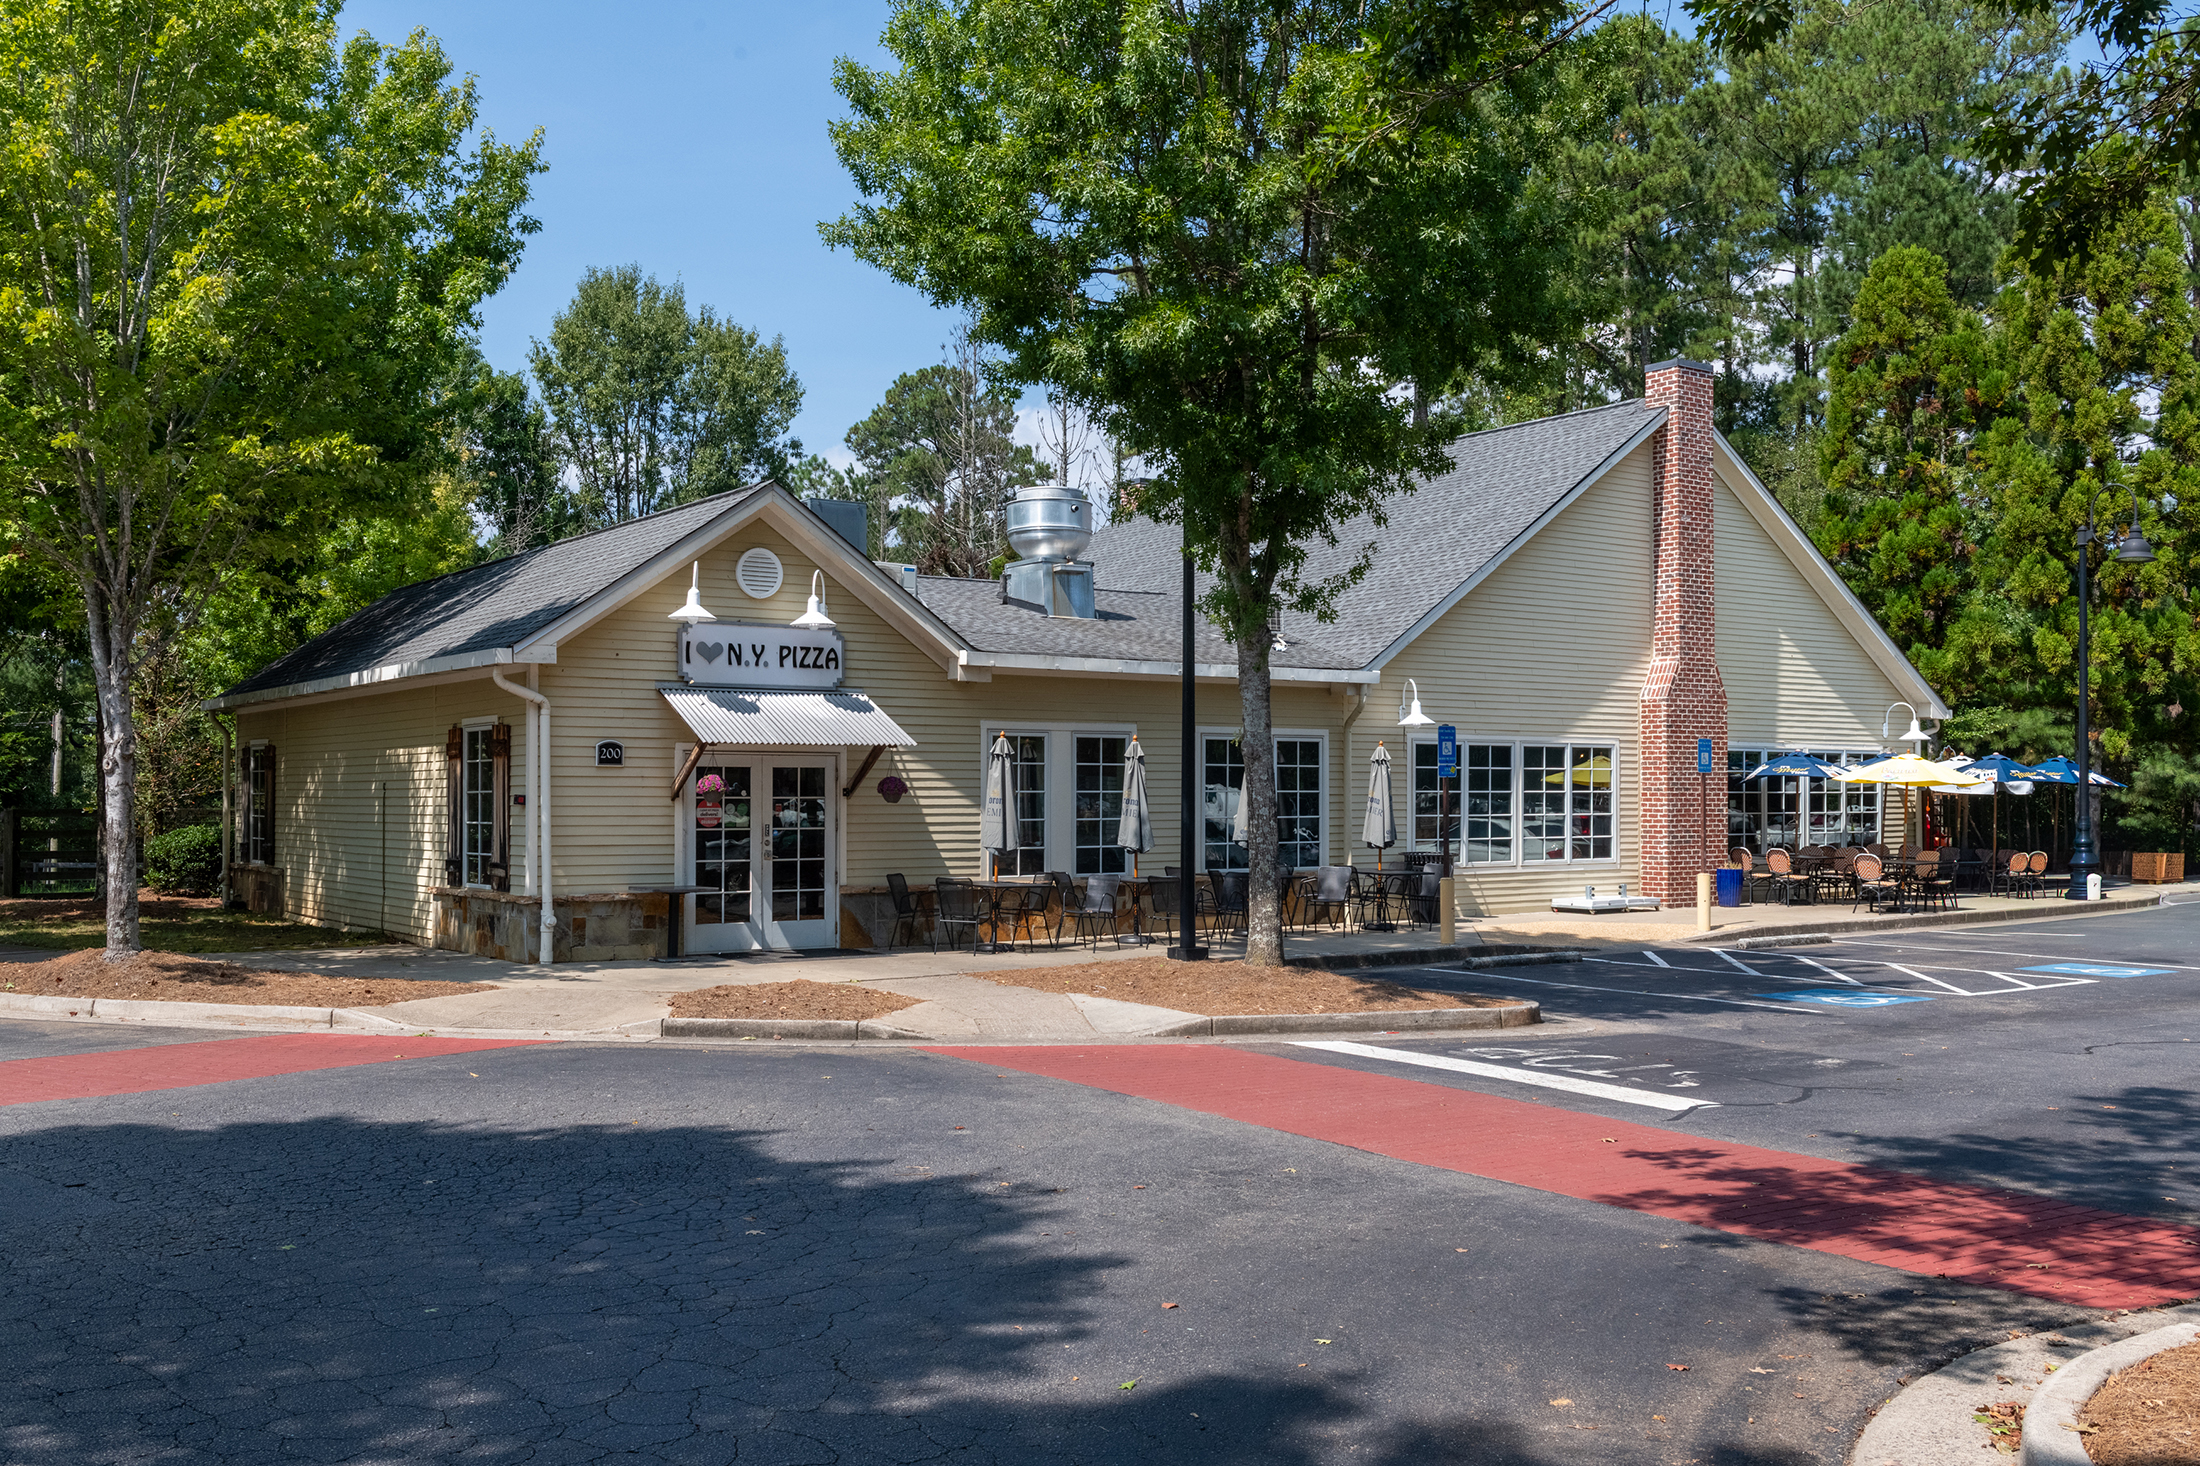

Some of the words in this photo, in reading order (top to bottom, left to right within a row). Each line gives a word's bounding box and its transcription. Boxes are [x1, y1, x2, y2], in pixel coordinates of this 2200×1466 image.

[685, 641, 691, 664] I
[727, 643, 769, 668] N.Y.
[779, 645, 840, 670] PIZZA
[600, 747, 621, 759] 200
